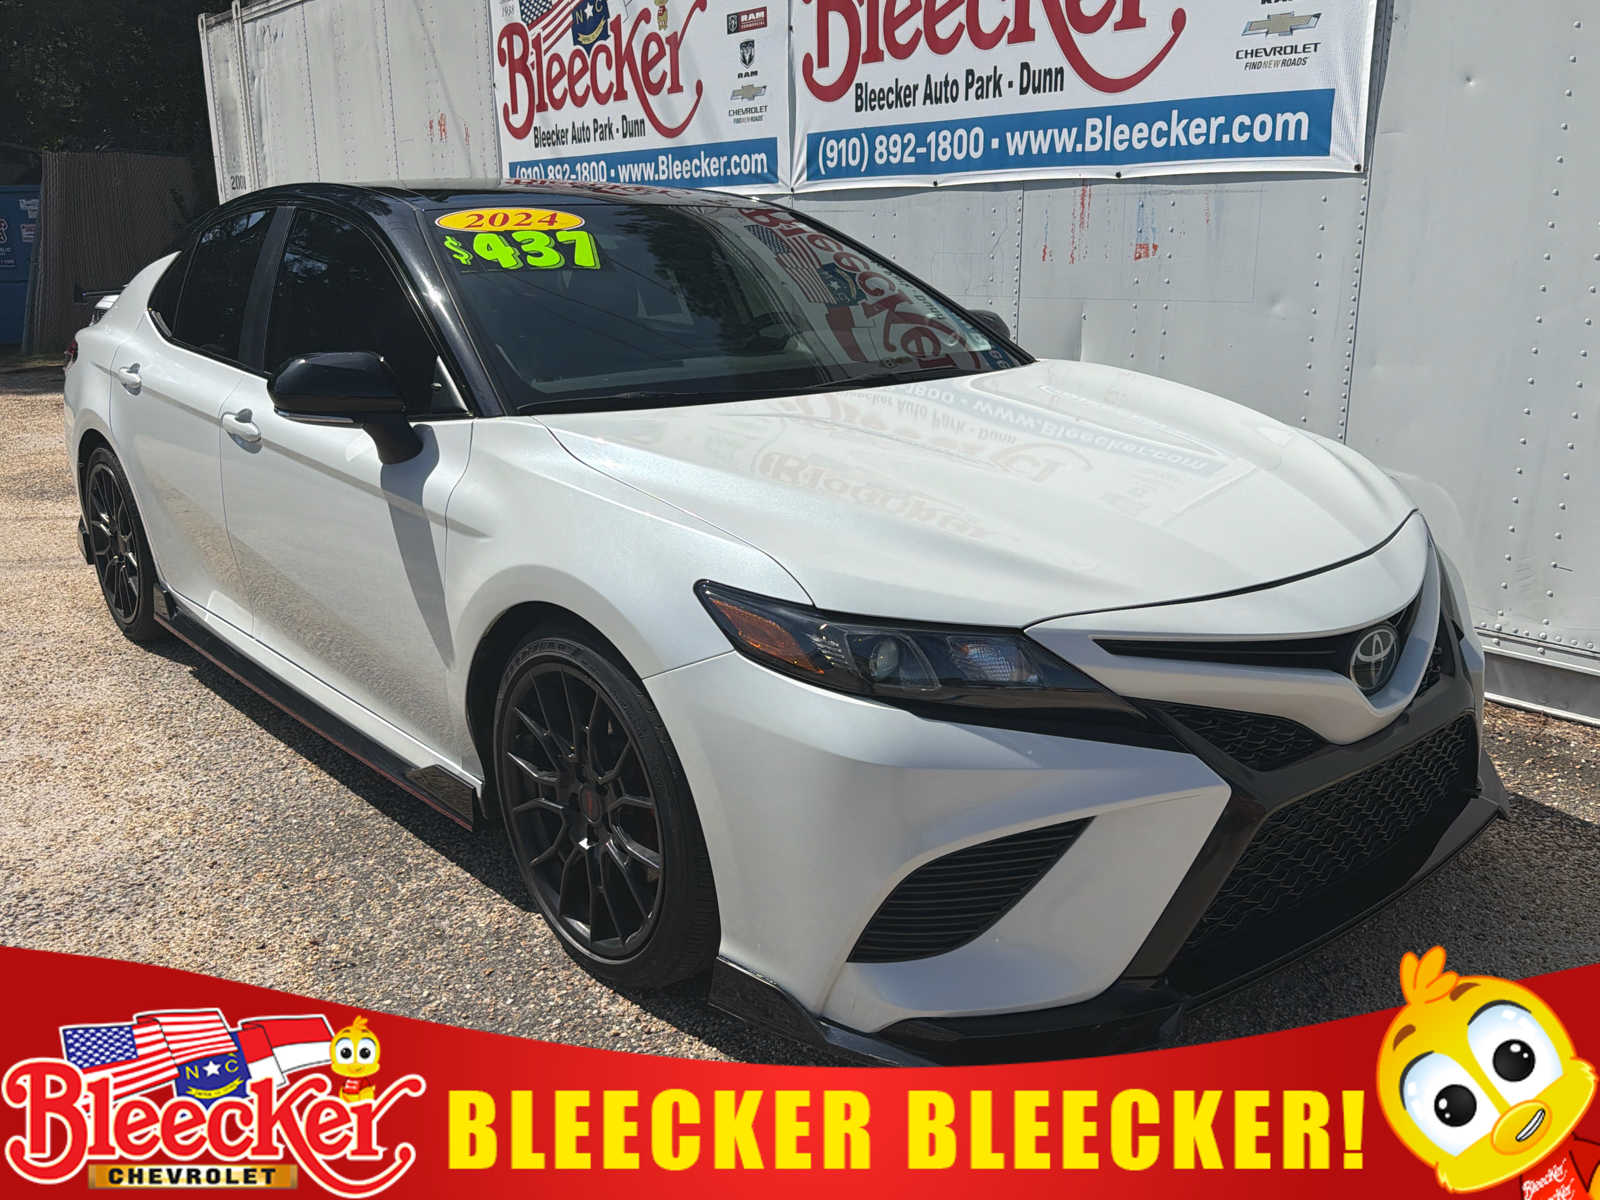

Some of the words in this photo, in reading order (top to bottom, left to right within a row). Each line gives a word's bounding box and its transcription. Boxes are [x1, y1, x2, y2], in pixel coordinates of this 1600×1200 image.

[740, 11, 765, 22] RAM
[1235, 42, 1321, 60] CHEVROLET
[737, 70, 759, 79] RAM
[854, 77, 919, 112] Bleecker
[922, 73, 960, 106] Auto
[964, 65, 1003, 101] Park
[1018, 61, 1065, 96] Dunn
[728, 105, 768, 117] CHEVROLET
[533, 116, 569, 149] Bleecker
[571, 121, 591, 145] Auto
[593, 116, 615, 142] Park
[621, 114, 646, 139] Dunn
[818, 132, 869, 175] (910)
[874, 126, 985, 165] 892-1800
[1005, 109, 1310, 157] www.Bleecker.com
[547, 160, 607, 182] 892-1800
[617, 151, 768, 183] www.Bleecker.com
[463, 211, 559, 229] 2024
[444, 229, 601, 270] $437
